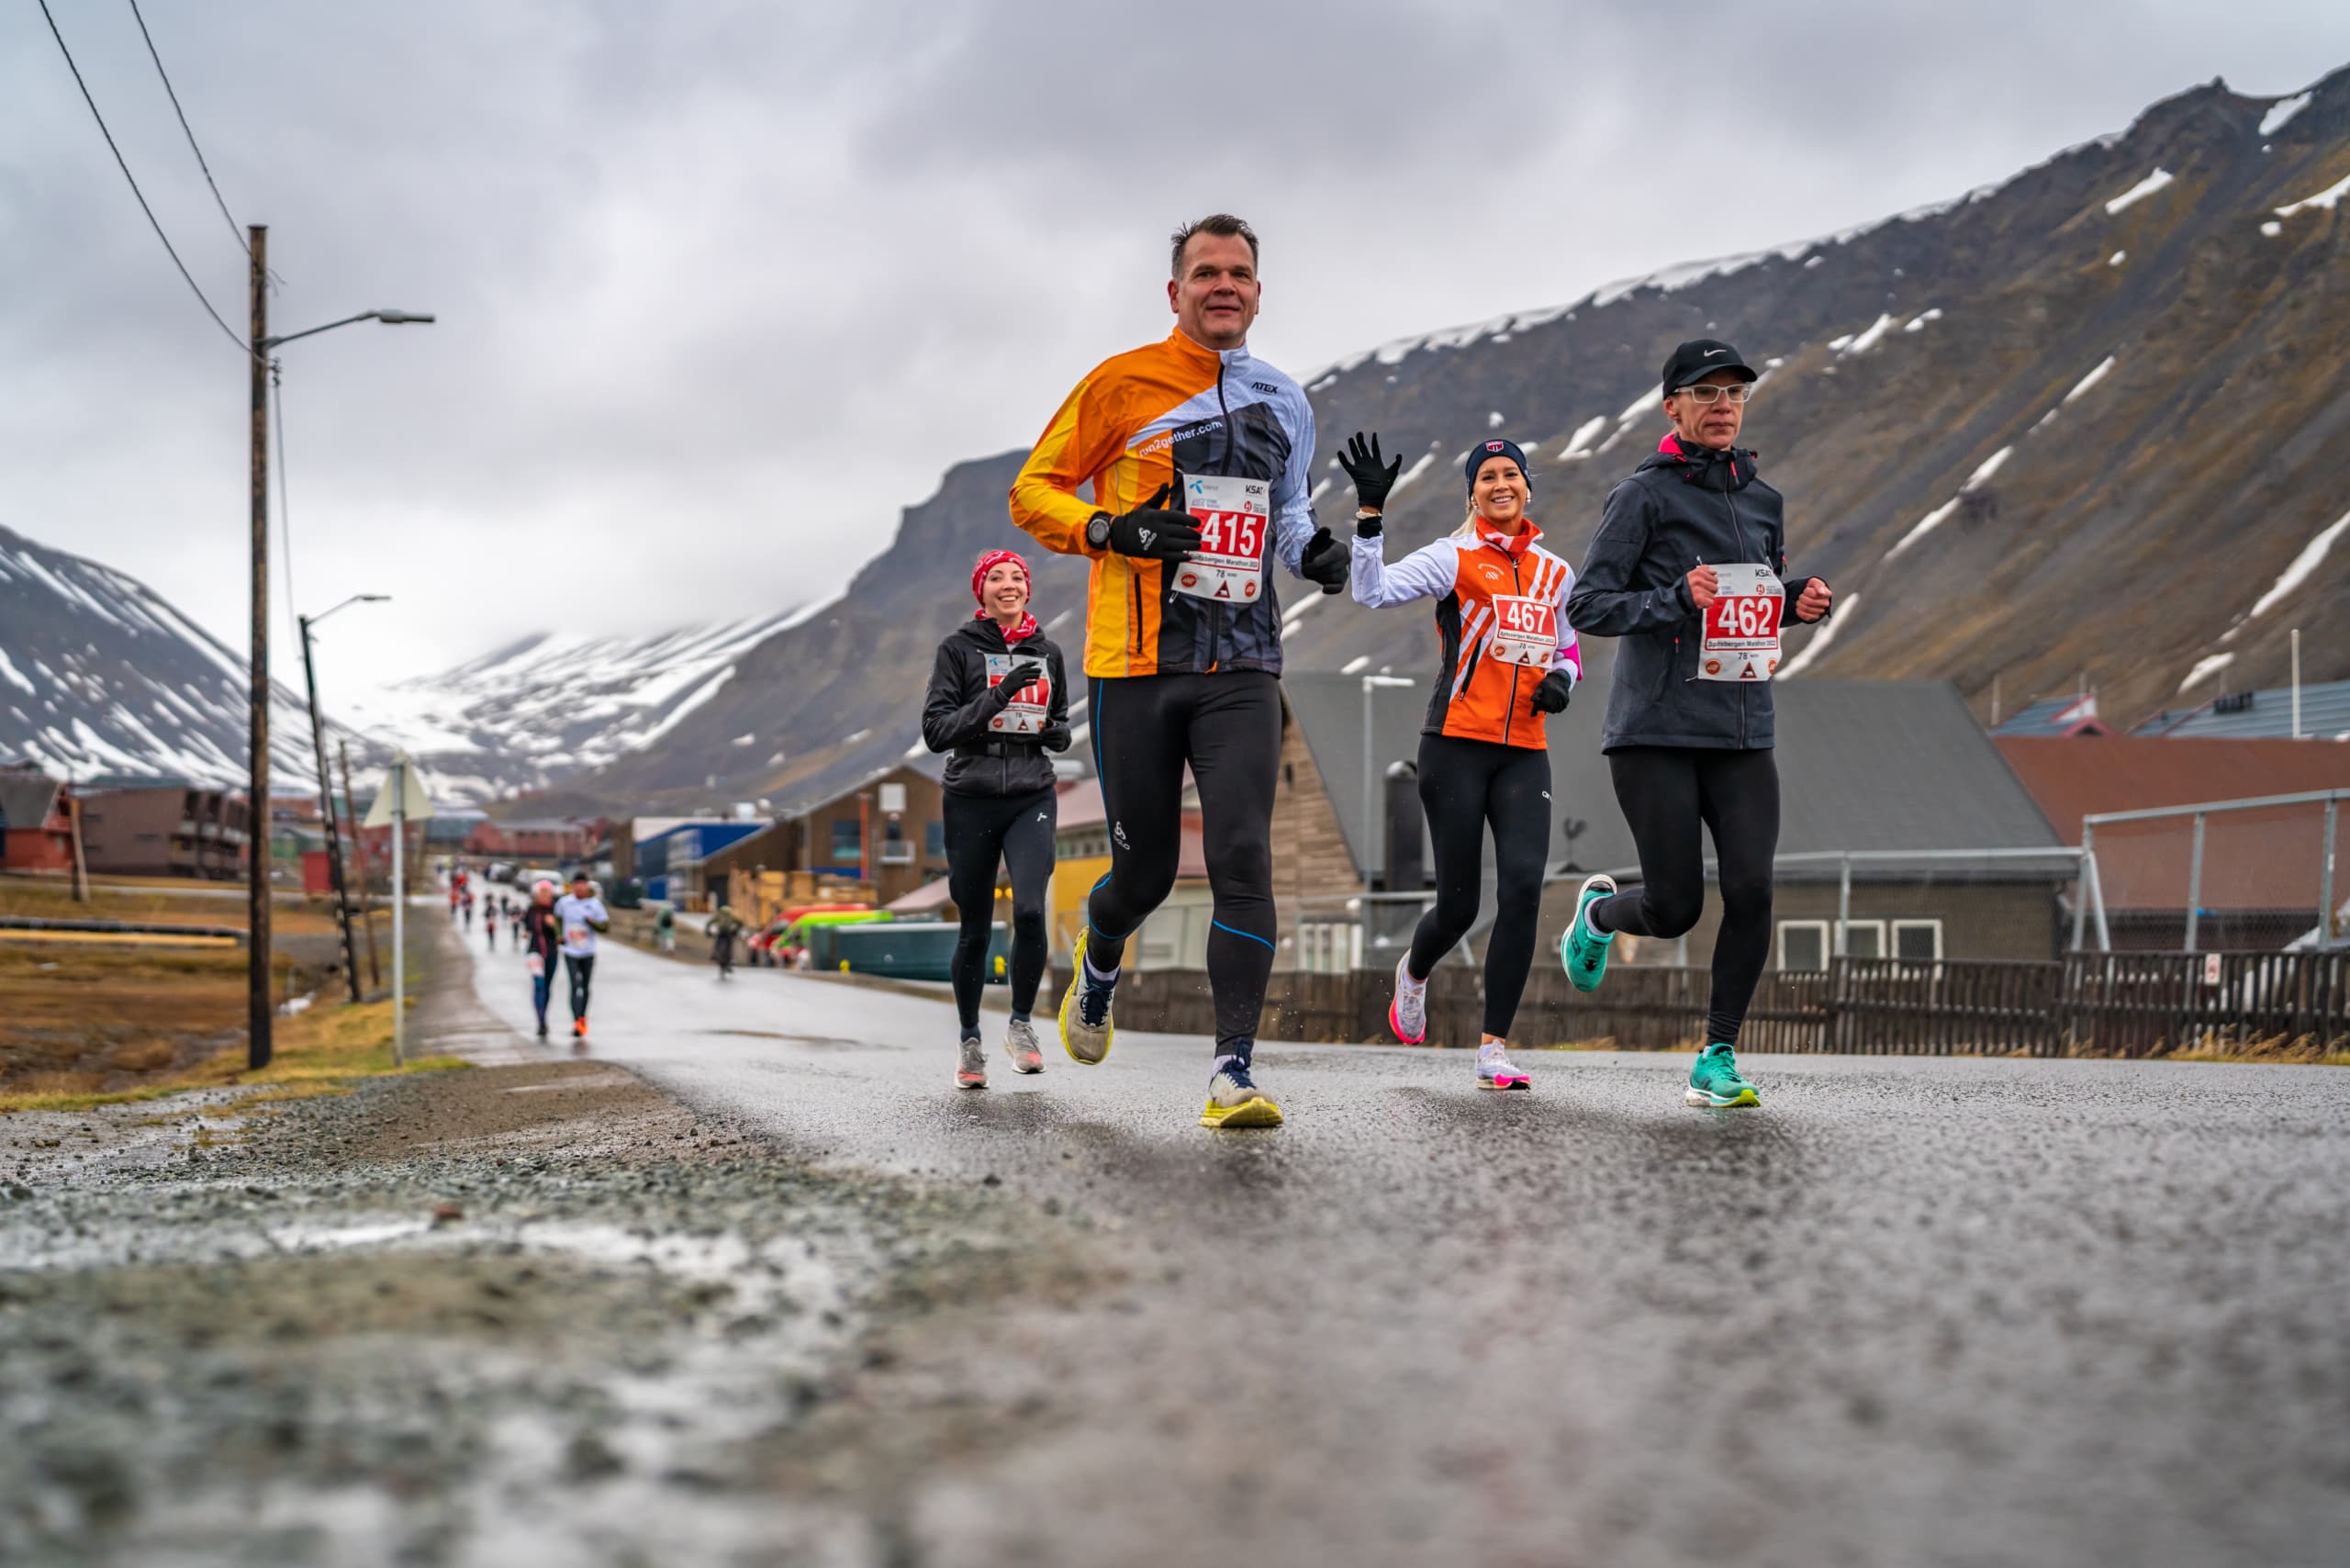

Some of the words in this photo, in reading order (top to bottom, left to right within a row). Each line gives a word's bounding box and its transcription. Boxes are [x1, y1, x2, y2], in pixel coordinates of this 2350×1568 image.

[1251, 382, 1278, 393] ATEX
[1139, 421, 1224, 457] run2gether.com
[1202, 512, 1257, 555] 415
[1507, 601, 1548, 633] 467
[1718, 598, 1773, 636] 462
[1738, 652, 1748, 660] 78
